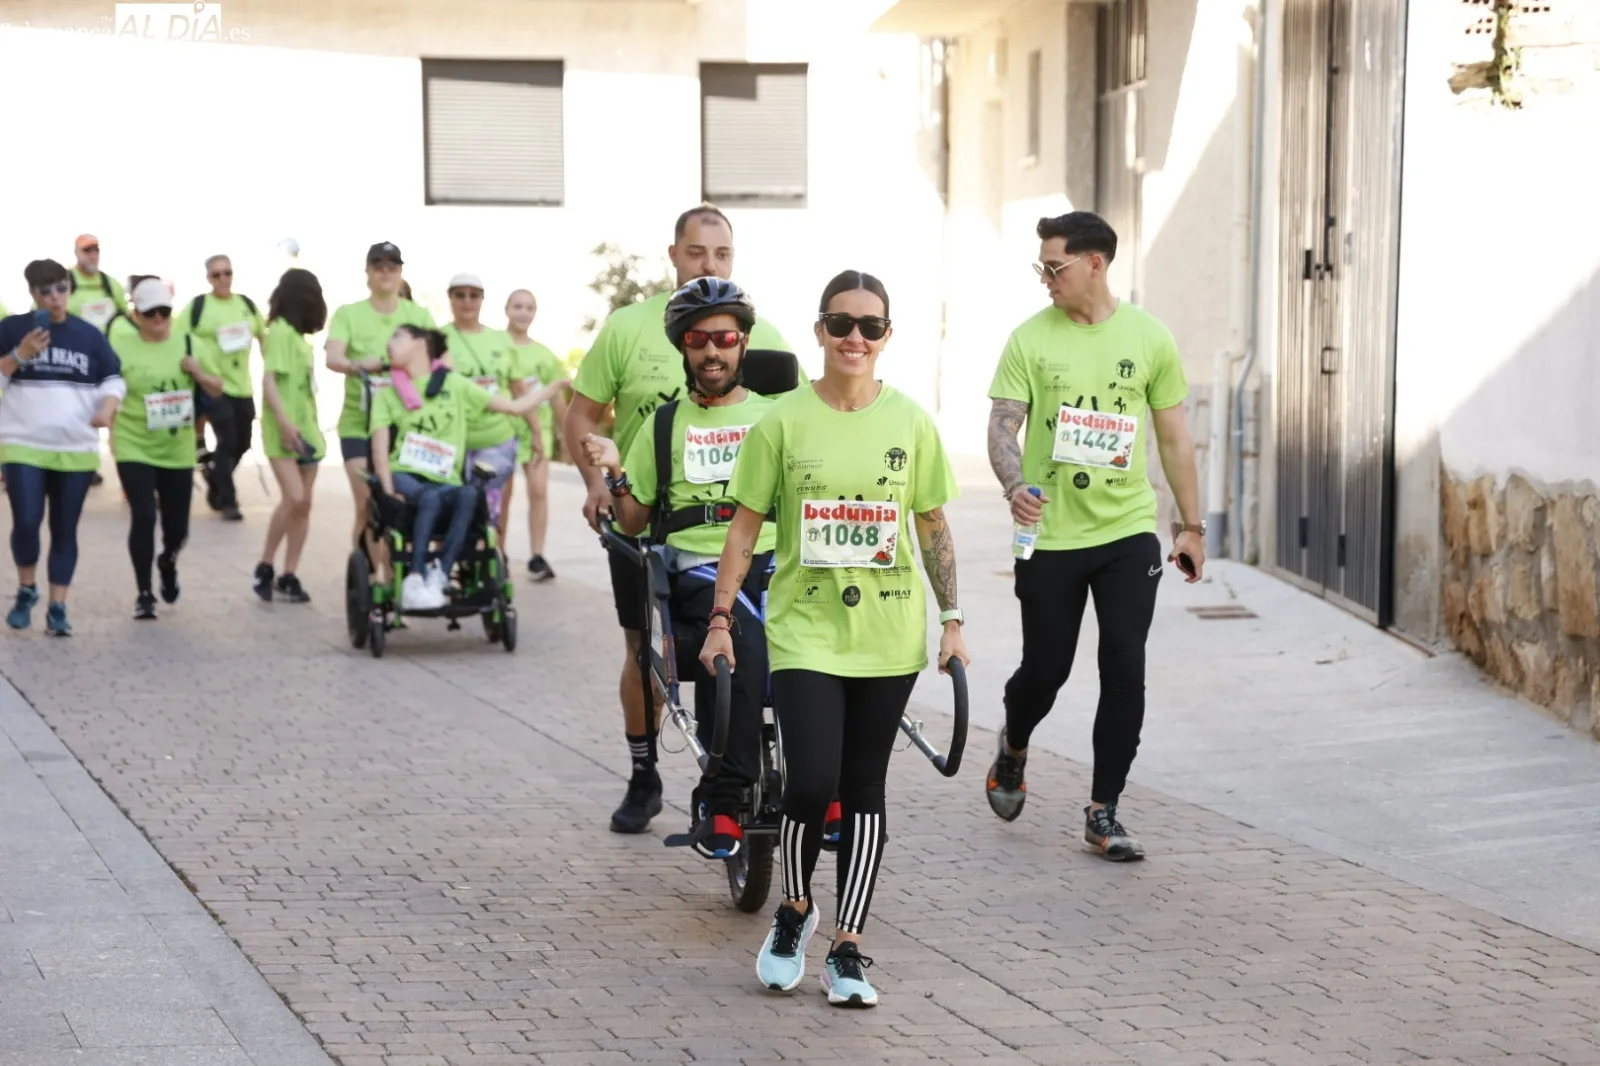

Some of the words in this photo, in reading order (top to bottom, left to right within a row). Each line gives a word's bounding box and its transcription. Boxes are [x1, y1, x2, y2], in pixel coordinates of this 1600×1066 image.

[51, 347, 89, 376] BEACH
[1060, 410, 1135, 433] bedunia
[686, 427, 747, 445] beduni
[1072, 428, 1120, 451] 1442
[696, 445, 741, 466] 106
[804, 503, 897, 522] bedunia
[821, 524, 879, 547] 1068
